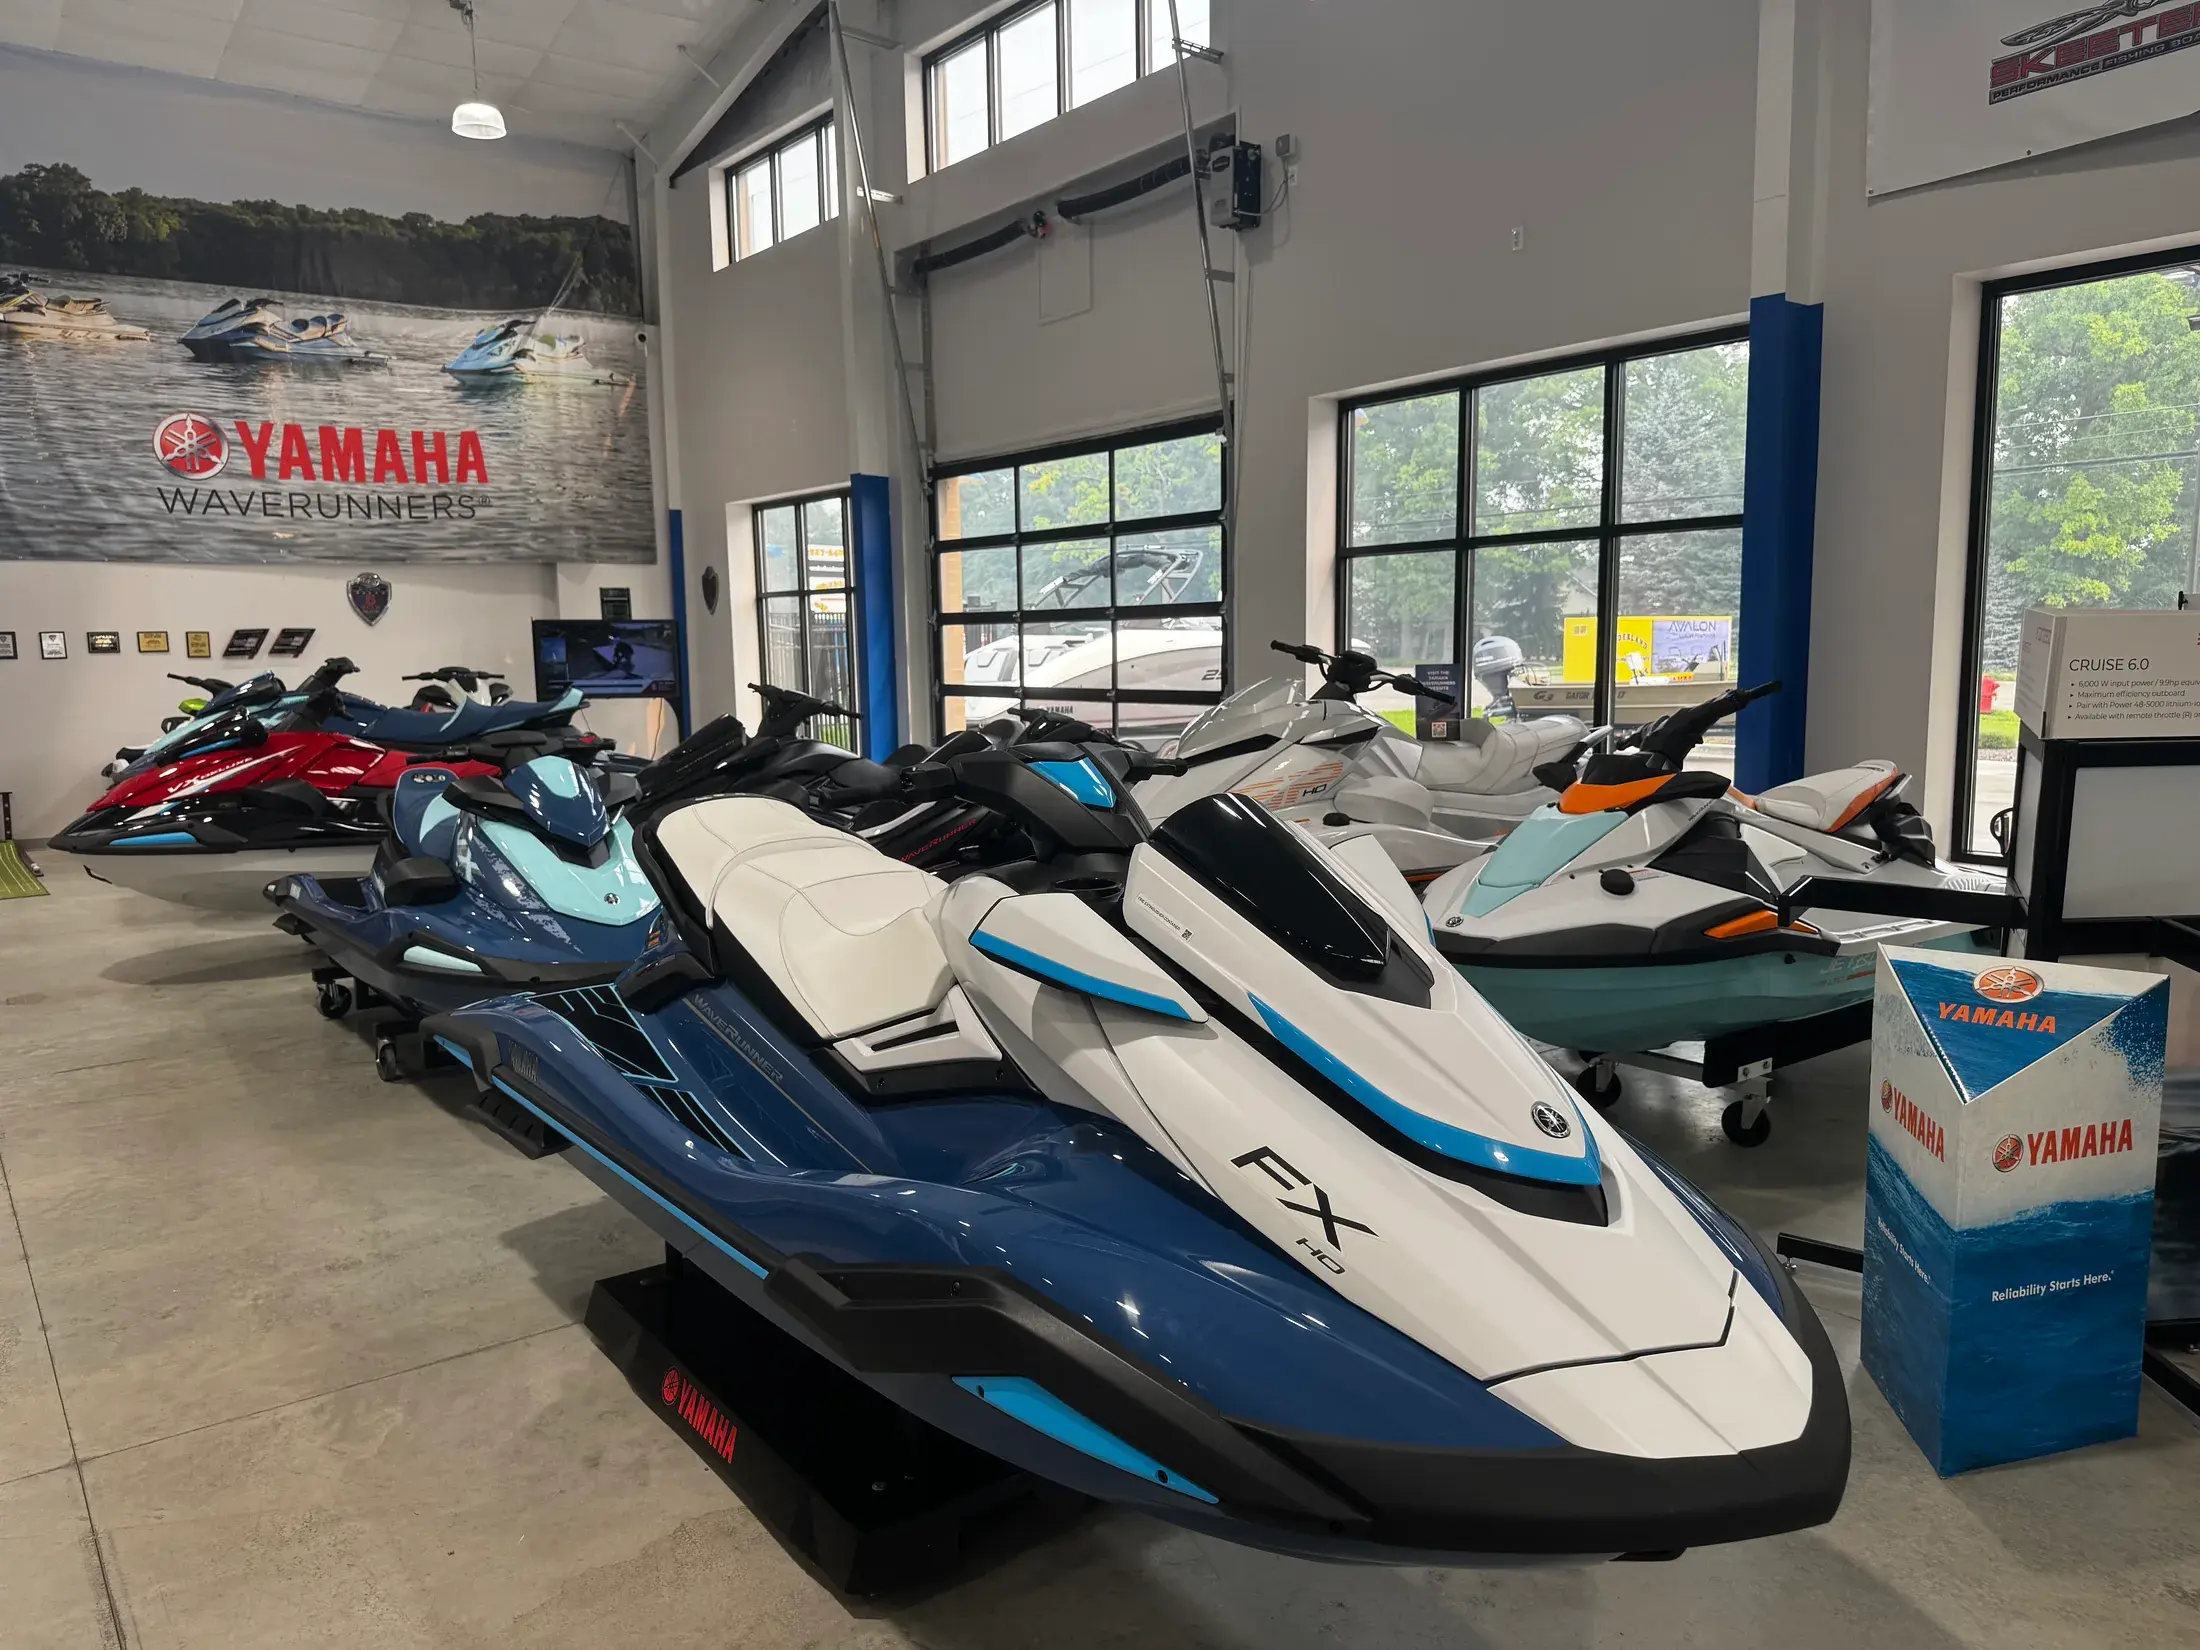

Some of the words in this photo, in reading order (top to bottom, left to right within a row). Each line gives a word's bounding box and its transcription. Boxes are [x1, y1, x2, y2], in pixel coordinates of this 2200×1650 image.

[1990, 3, 2200, 89] SKEETE
[1992, 62, 2101, 101] PERFORMANCE
[2103, 43, 2165, 70] FISHING
[234, 420, 489, 484] YAMAHA
[1668, 621, 1717, 632] AVALON
[2069, 658, 2125, 672] CRUISE
[2128, 658, 2150, 671] 6.0
[2077, 690, 2115, 698] Maximum
[2116, 690, 2151, 699] efficiency
[2110, 680, 2130, 688] input
[2131, 681, 2154, 689] power
[1046, 705, 1074, 714] YAMAHA
[2074, 712, 2108, 720] Available
[2108, 712, 2125, 720] with
[2076, 701, 2091, 709] Pair
[2092, 701, 2109, 709] with
[2110, 701, 2133, 709] Power
[2134, 701, 2165, 709] 48-5000
[1302, 783, 1328, 797] HO
[1939, 1001, 2057, 1034] YAMAHA
[693, 994, 784, 1082] WAVERUNNER
[1893, 1086, 1945, 1164] YAMAHA
[2027, 1118, 2133, 1167] YAMAHA
[1230, 1145, 1380, 1252] FX
[1295, 1237, 1346, 1275] HO
[1899, 1243, 1914, 1268] Starts
[1991, 1283, 2047, 1302] Reliability
[2049, 1277, 2081, 1292] Starts
[678, 1378, 738, 1465] YAMAHA
